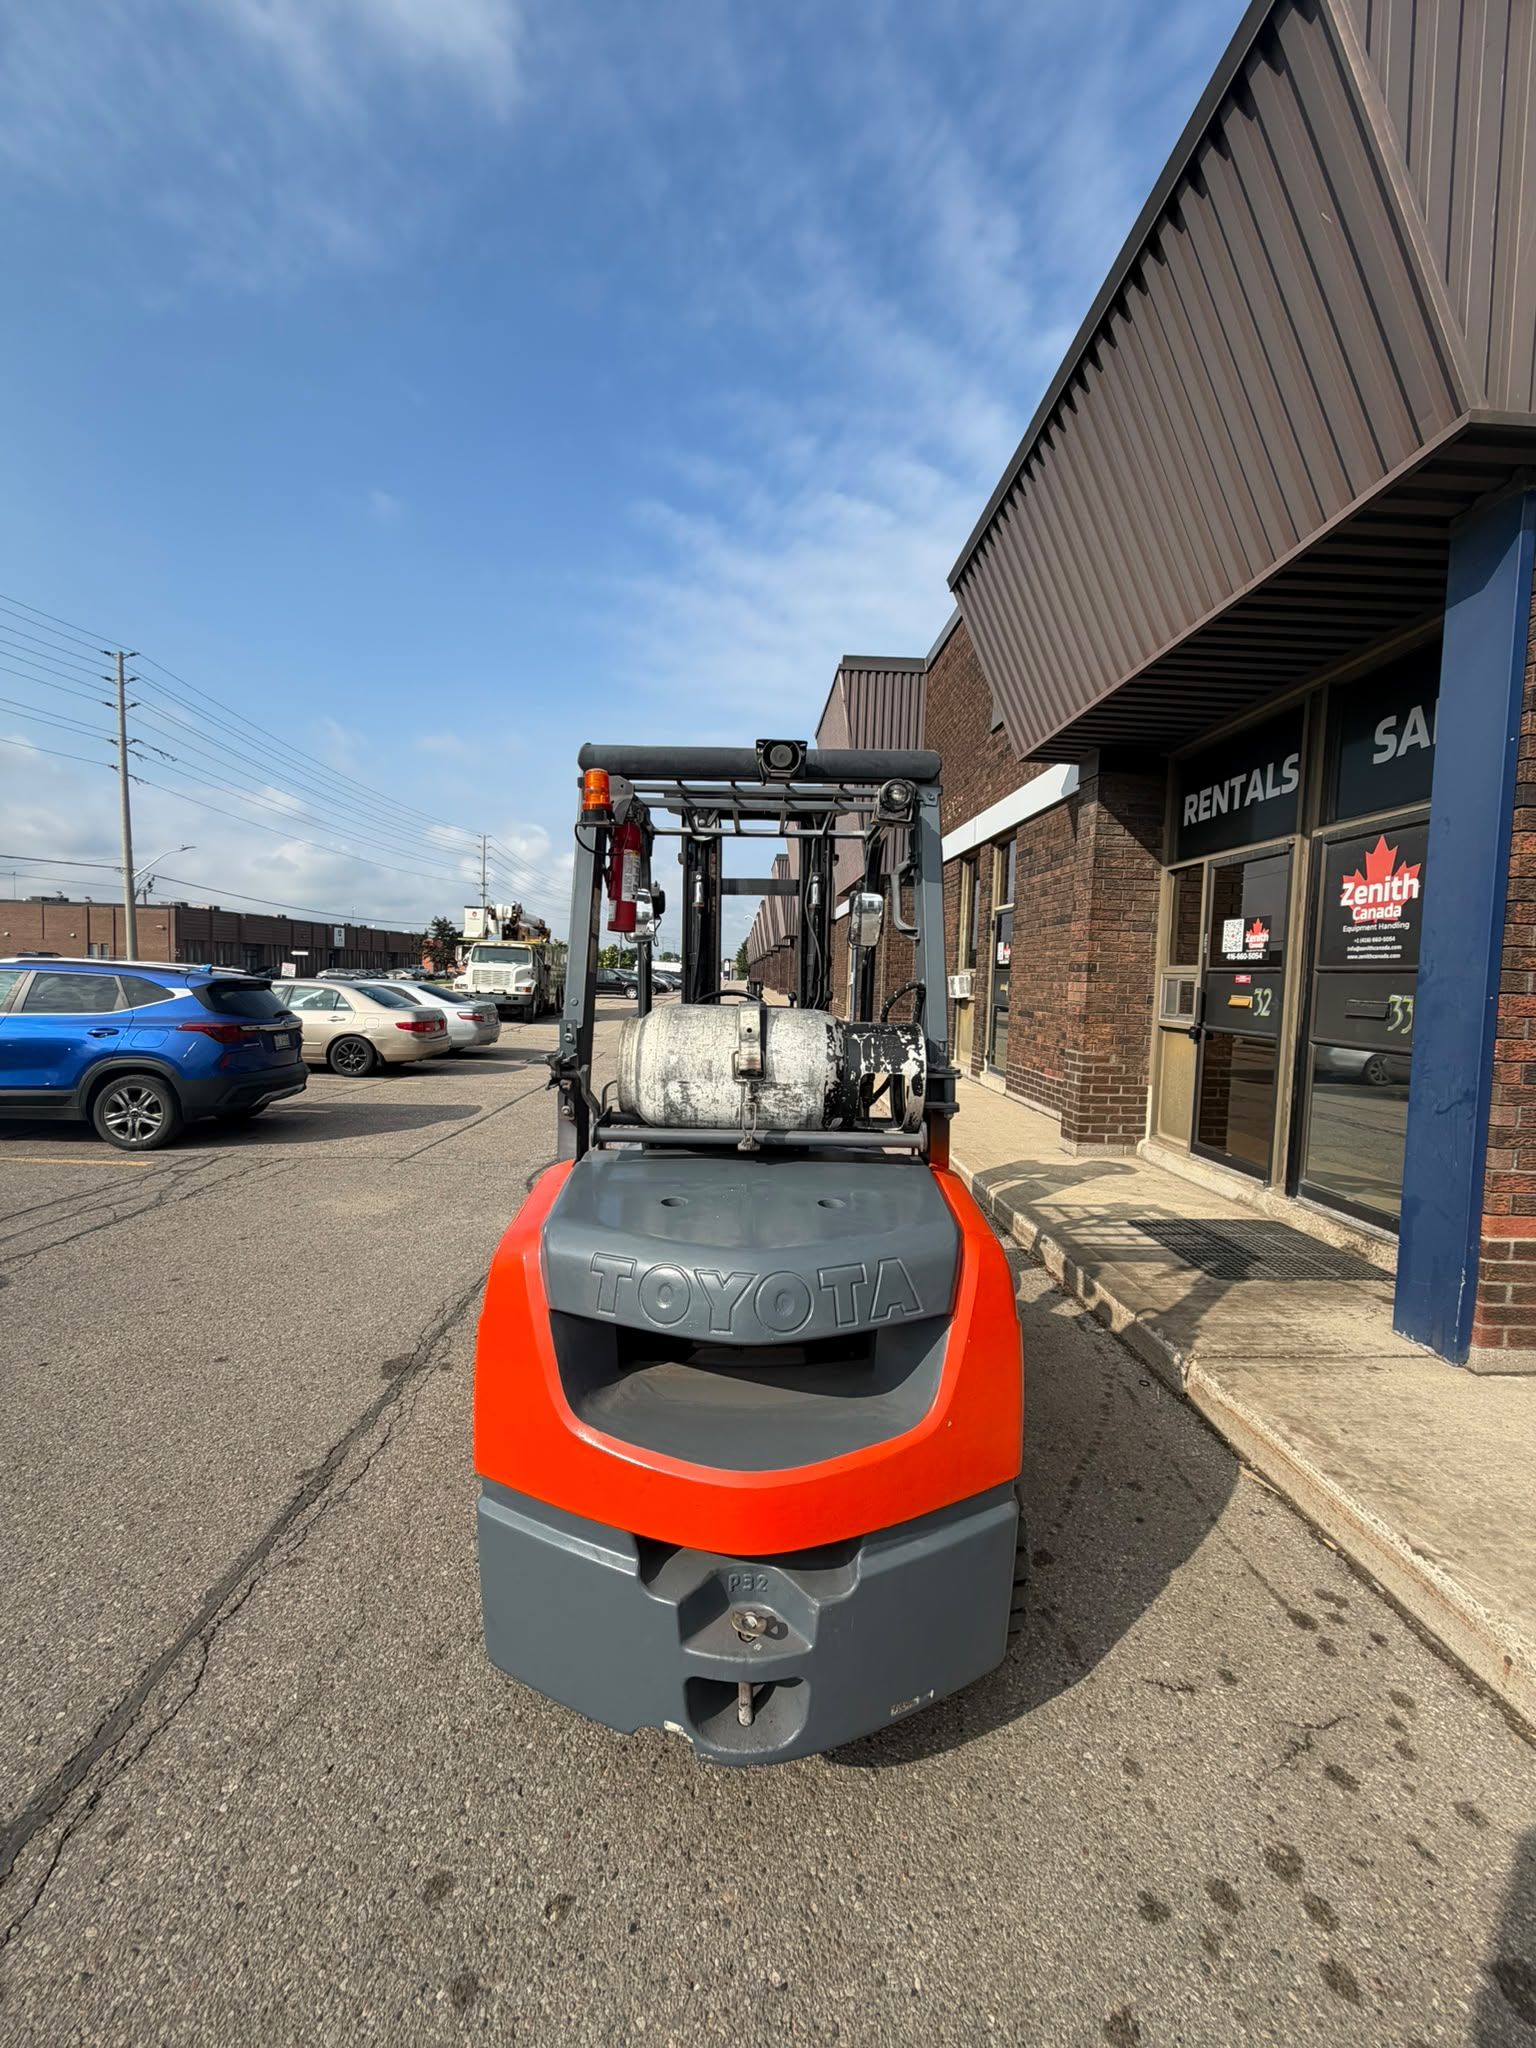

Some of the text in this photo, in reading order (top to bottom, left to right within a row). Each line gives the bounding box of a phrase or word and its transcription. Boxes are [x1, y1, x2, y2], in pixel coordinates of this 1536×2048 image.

[1373, 698, 1438, 764] SA
[1183, 753, 1299, 826] RENTALS
[1340, 872, 1420, 907] Zenith
[1352, 902, 1402, 921] Canada
[1245, 932, 1269, 943] Zenith
[1342, 921, 1410, 933] Equipment Handling
[1226, 952, 1263, 960] 416-660-5054
[1253, 987, 1273, 1017] 32
[1386, 994, 1415, 1034] 33
[590, 1251, 924, 1336] TOYOTA
[728, 1573, 769, 1592] P32
